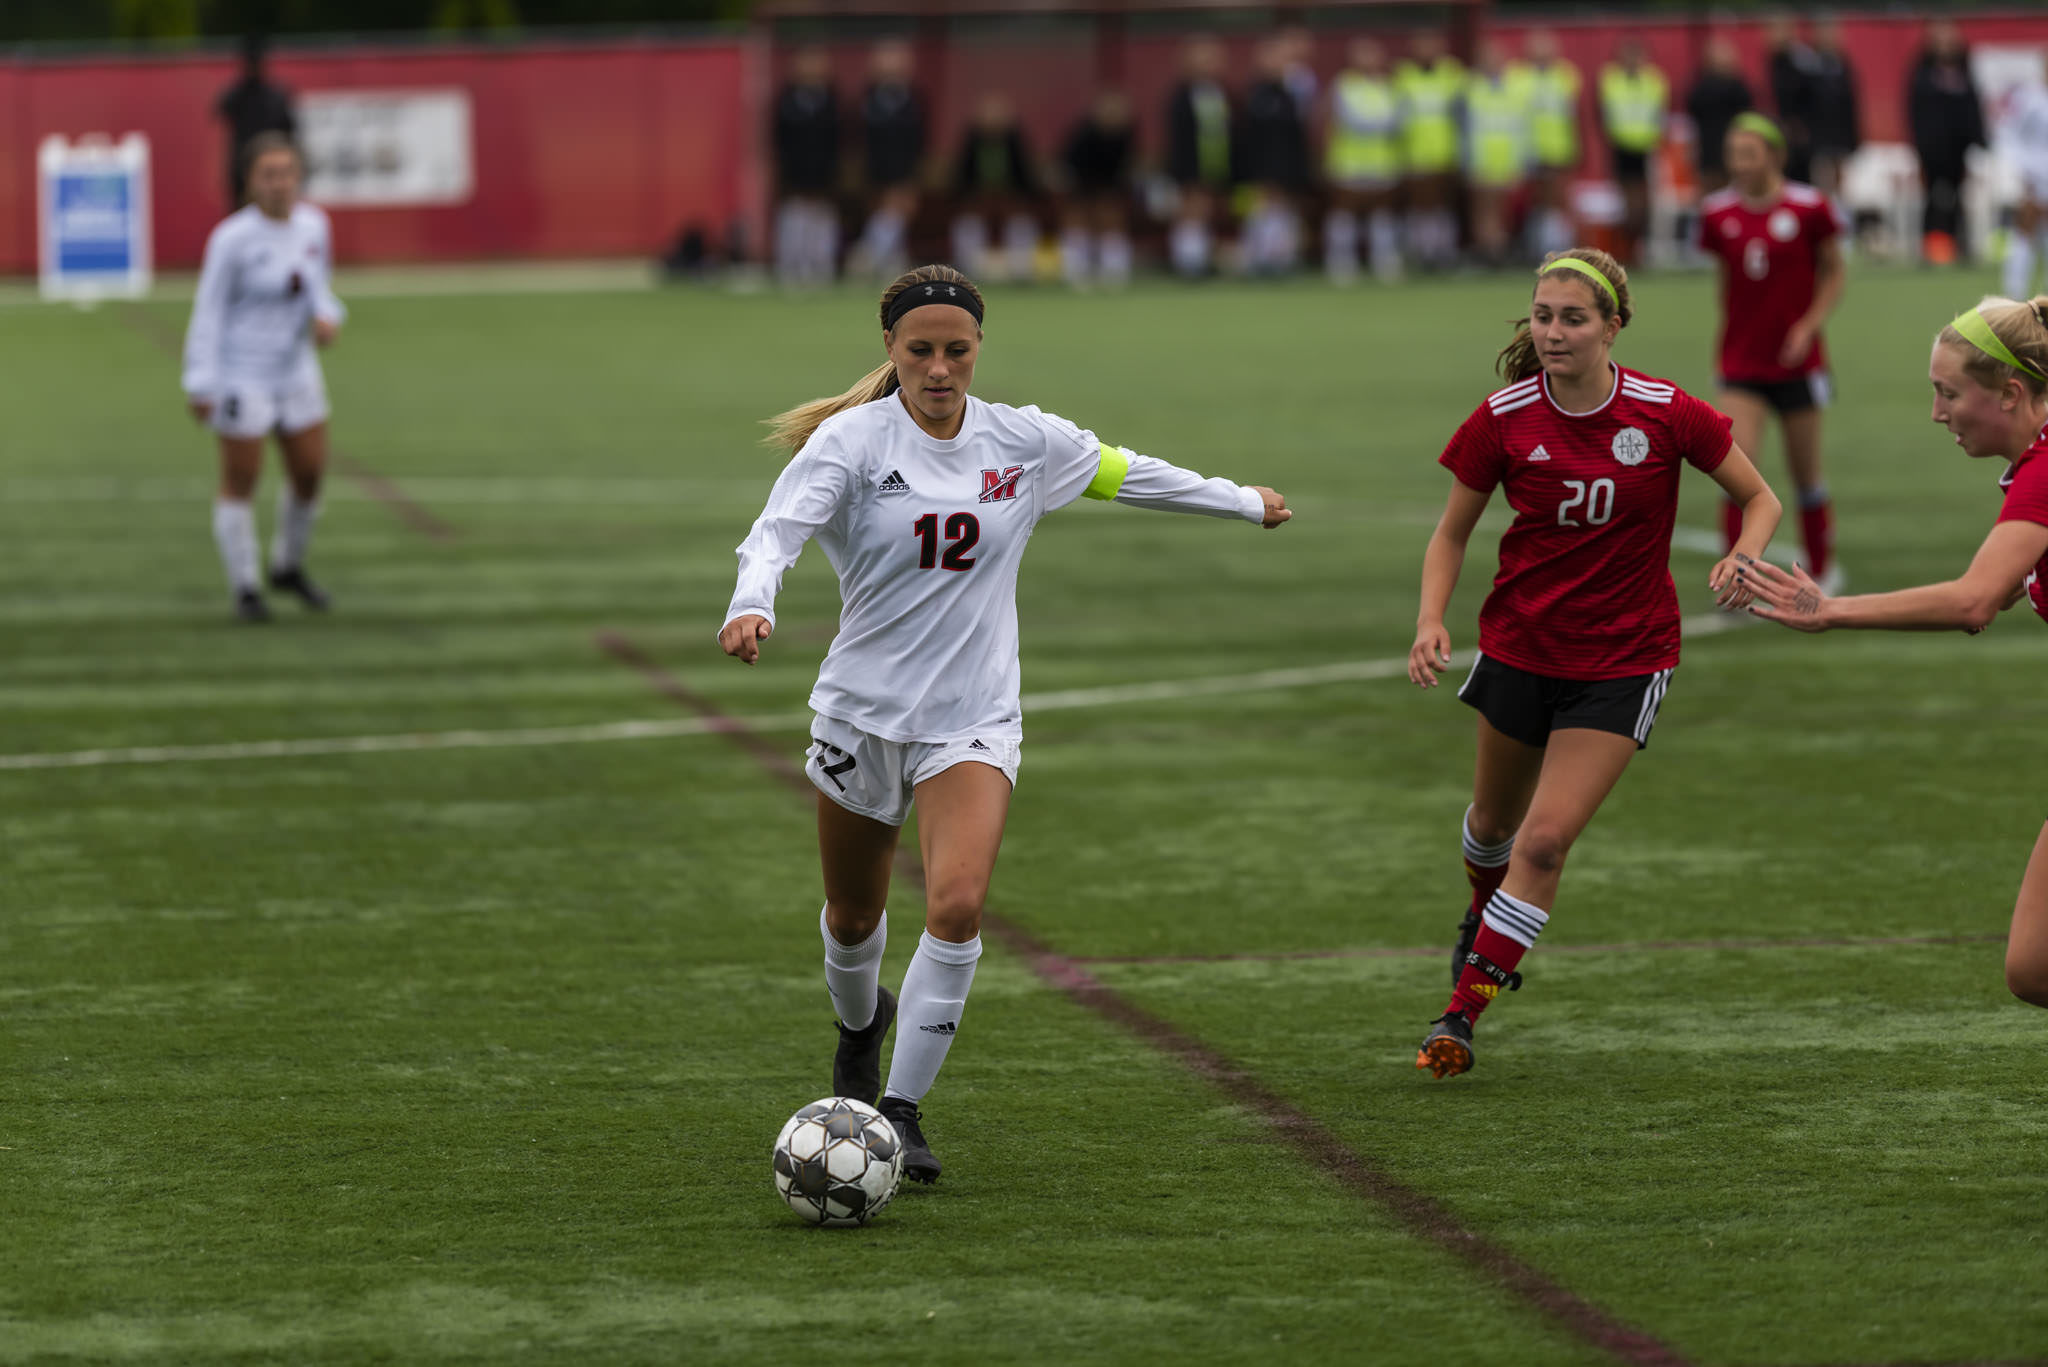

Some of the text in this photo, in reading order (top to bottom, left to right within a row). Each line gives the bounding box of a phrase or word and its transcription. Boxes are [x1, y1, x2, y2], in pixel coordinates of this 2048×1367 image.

[879, 483, 910, 491] adidas
[979, 464, 1024, 503] M
[1558, 478, 1615, 527] 20
[914, 512, 980, 571] 12
